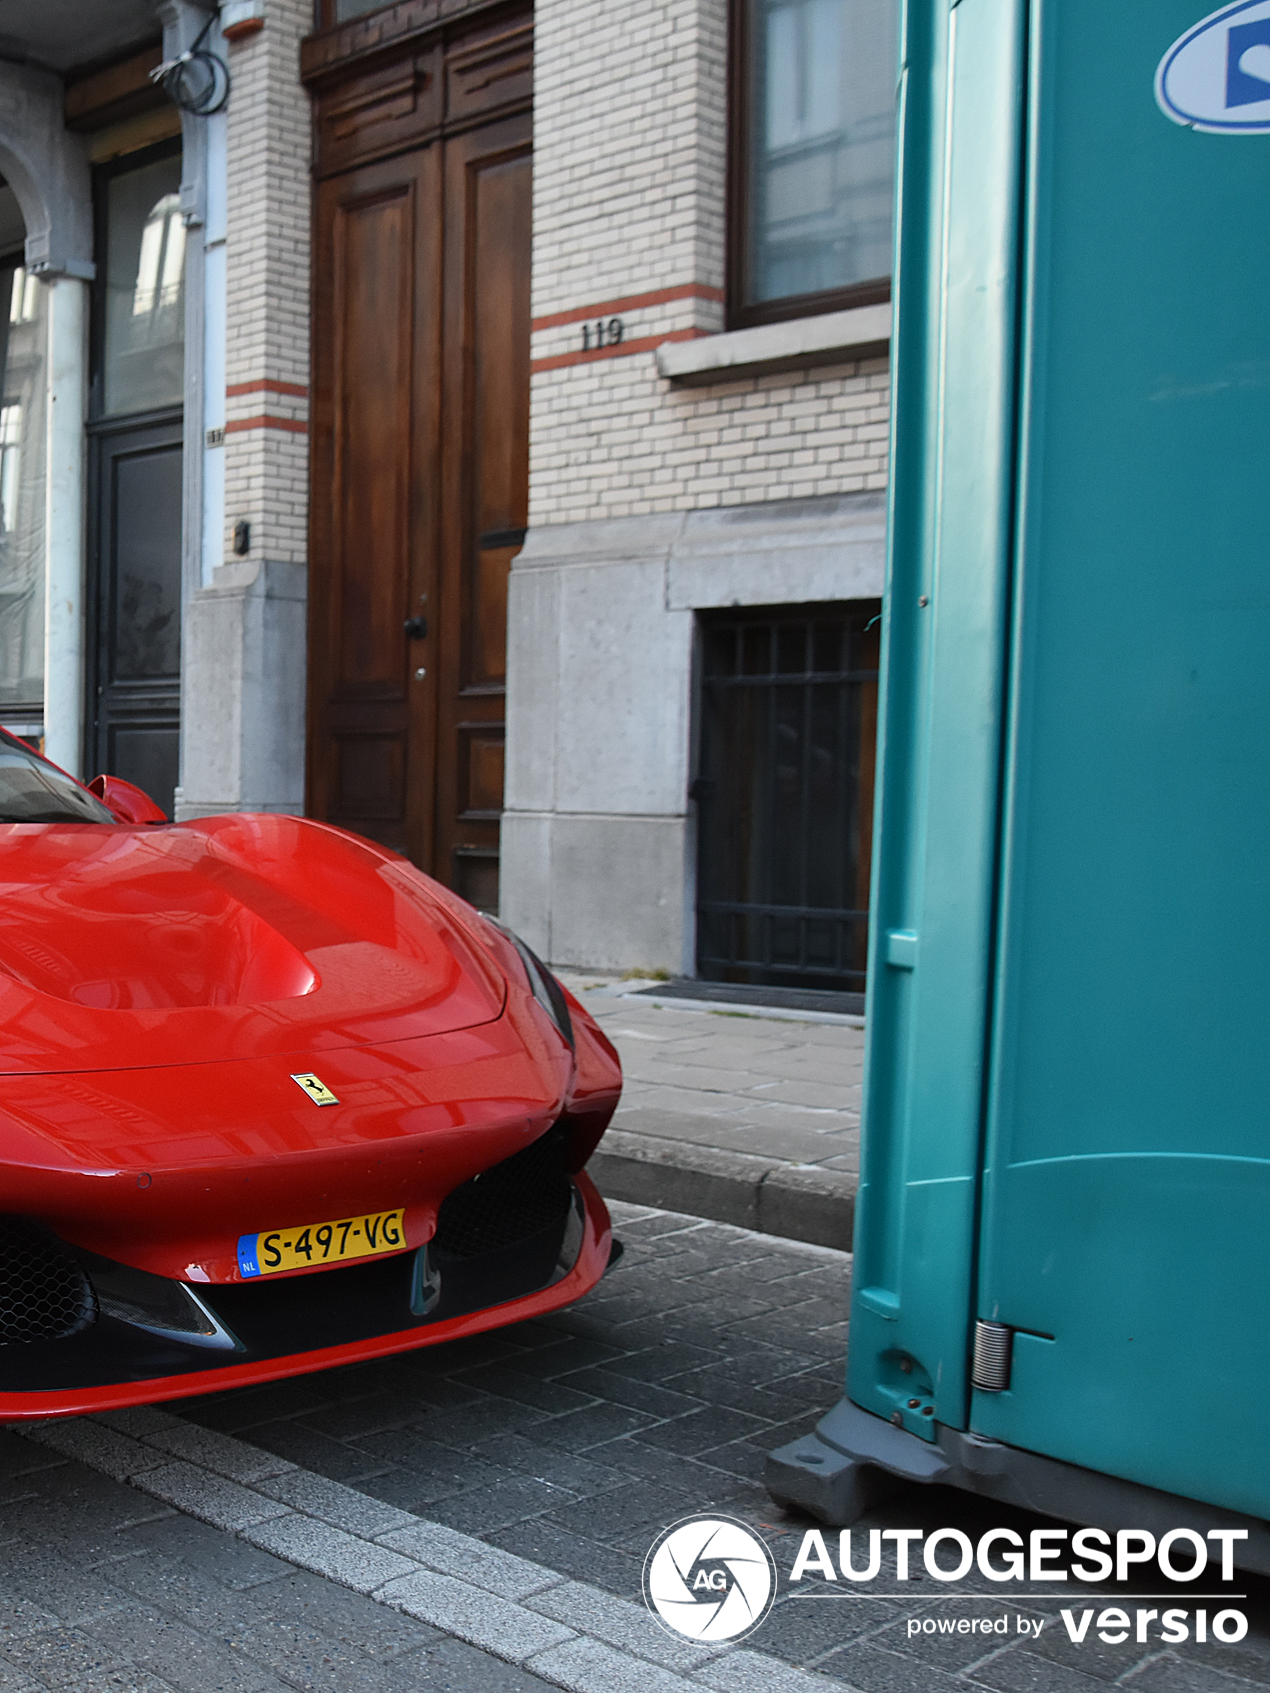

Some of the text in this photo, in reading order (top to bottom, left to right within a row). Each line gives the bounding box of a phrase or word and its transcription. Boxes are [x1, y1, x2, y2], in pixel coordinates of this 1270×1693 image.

[582, 318, 623, 352] 119
[242, 1213, 400, 1273] NL S-497-VG
